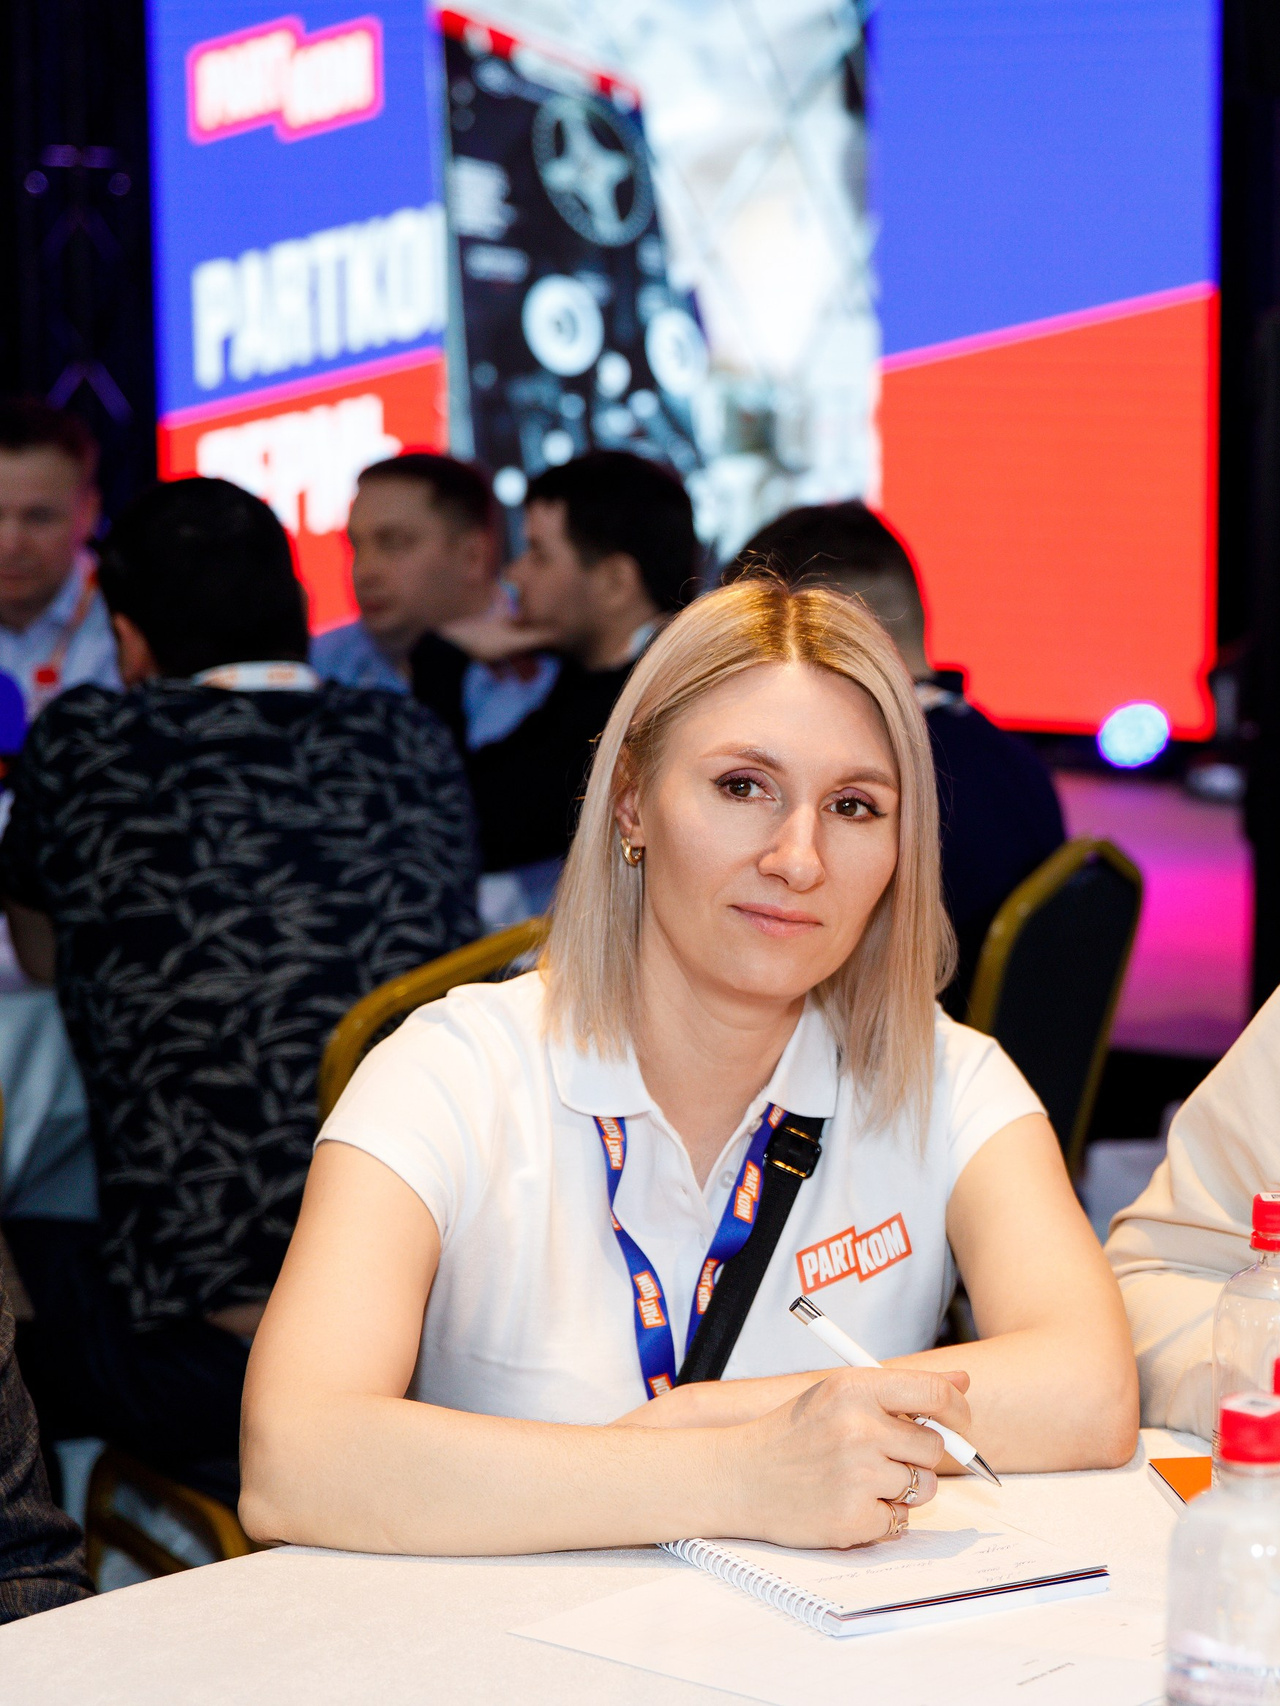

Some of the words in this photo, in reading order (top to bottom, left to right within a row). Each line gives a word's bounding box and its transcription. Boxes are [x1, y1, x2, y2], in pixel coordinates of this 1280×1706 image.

[769, 1105, 784, 1126] OM
[606, 1137, 621, 1167] PART
[747, 1164, 760, 1200] PART
[736, 1188, 752, 1221] KOM
[801, 1235, 855, 1288] PART
[855, 1219, 908, 1274] KOM
[636, 1273, 659, 1300] KOM
[702, 1260, 717, 1289] PART
[641, 1298, 663, 1327] PART
[651, 1376, 671, 1397] OM
